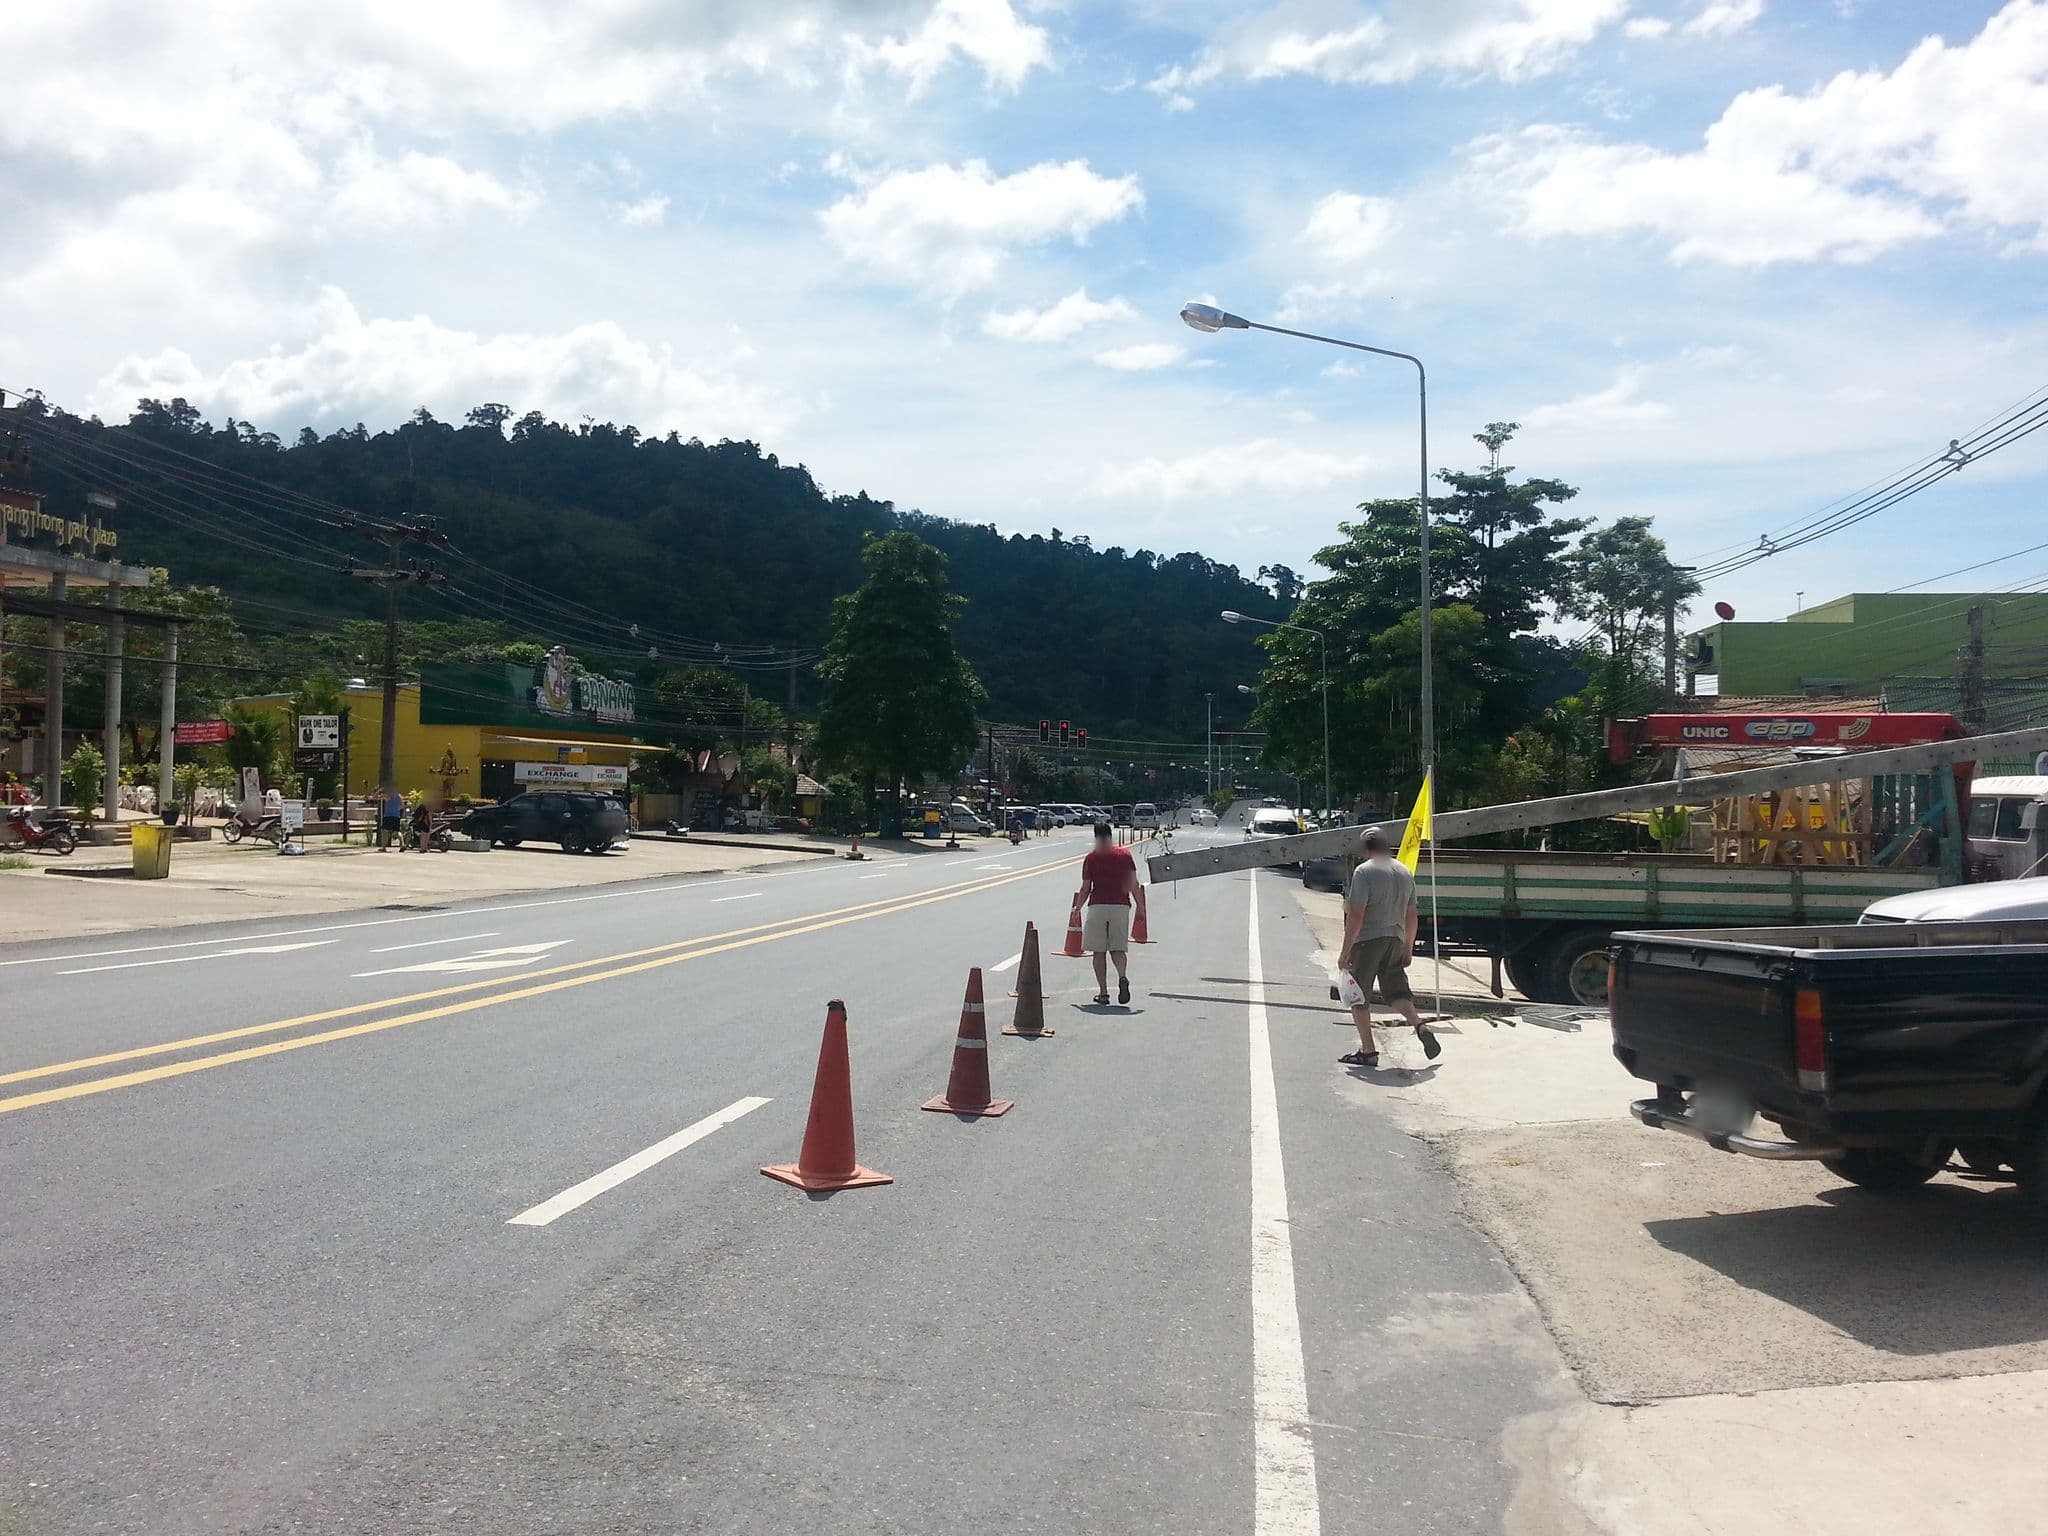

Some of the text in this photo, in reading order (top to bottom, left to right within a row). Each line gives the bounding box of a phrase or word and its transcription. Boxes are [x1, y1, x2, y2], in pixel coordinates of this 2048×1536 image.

[68, 514, 90, 544] park
[93, 518, 117, 554] plaza
[580, 678, 635, 712] BANANA
[300, 719, 338, 728] MARK ONE TAILOR
[1752, 721, 1808, 736] 330
[1683, 726, 1729, 738] UNIC
[527, 769, 579, 778] EXCHANGE
